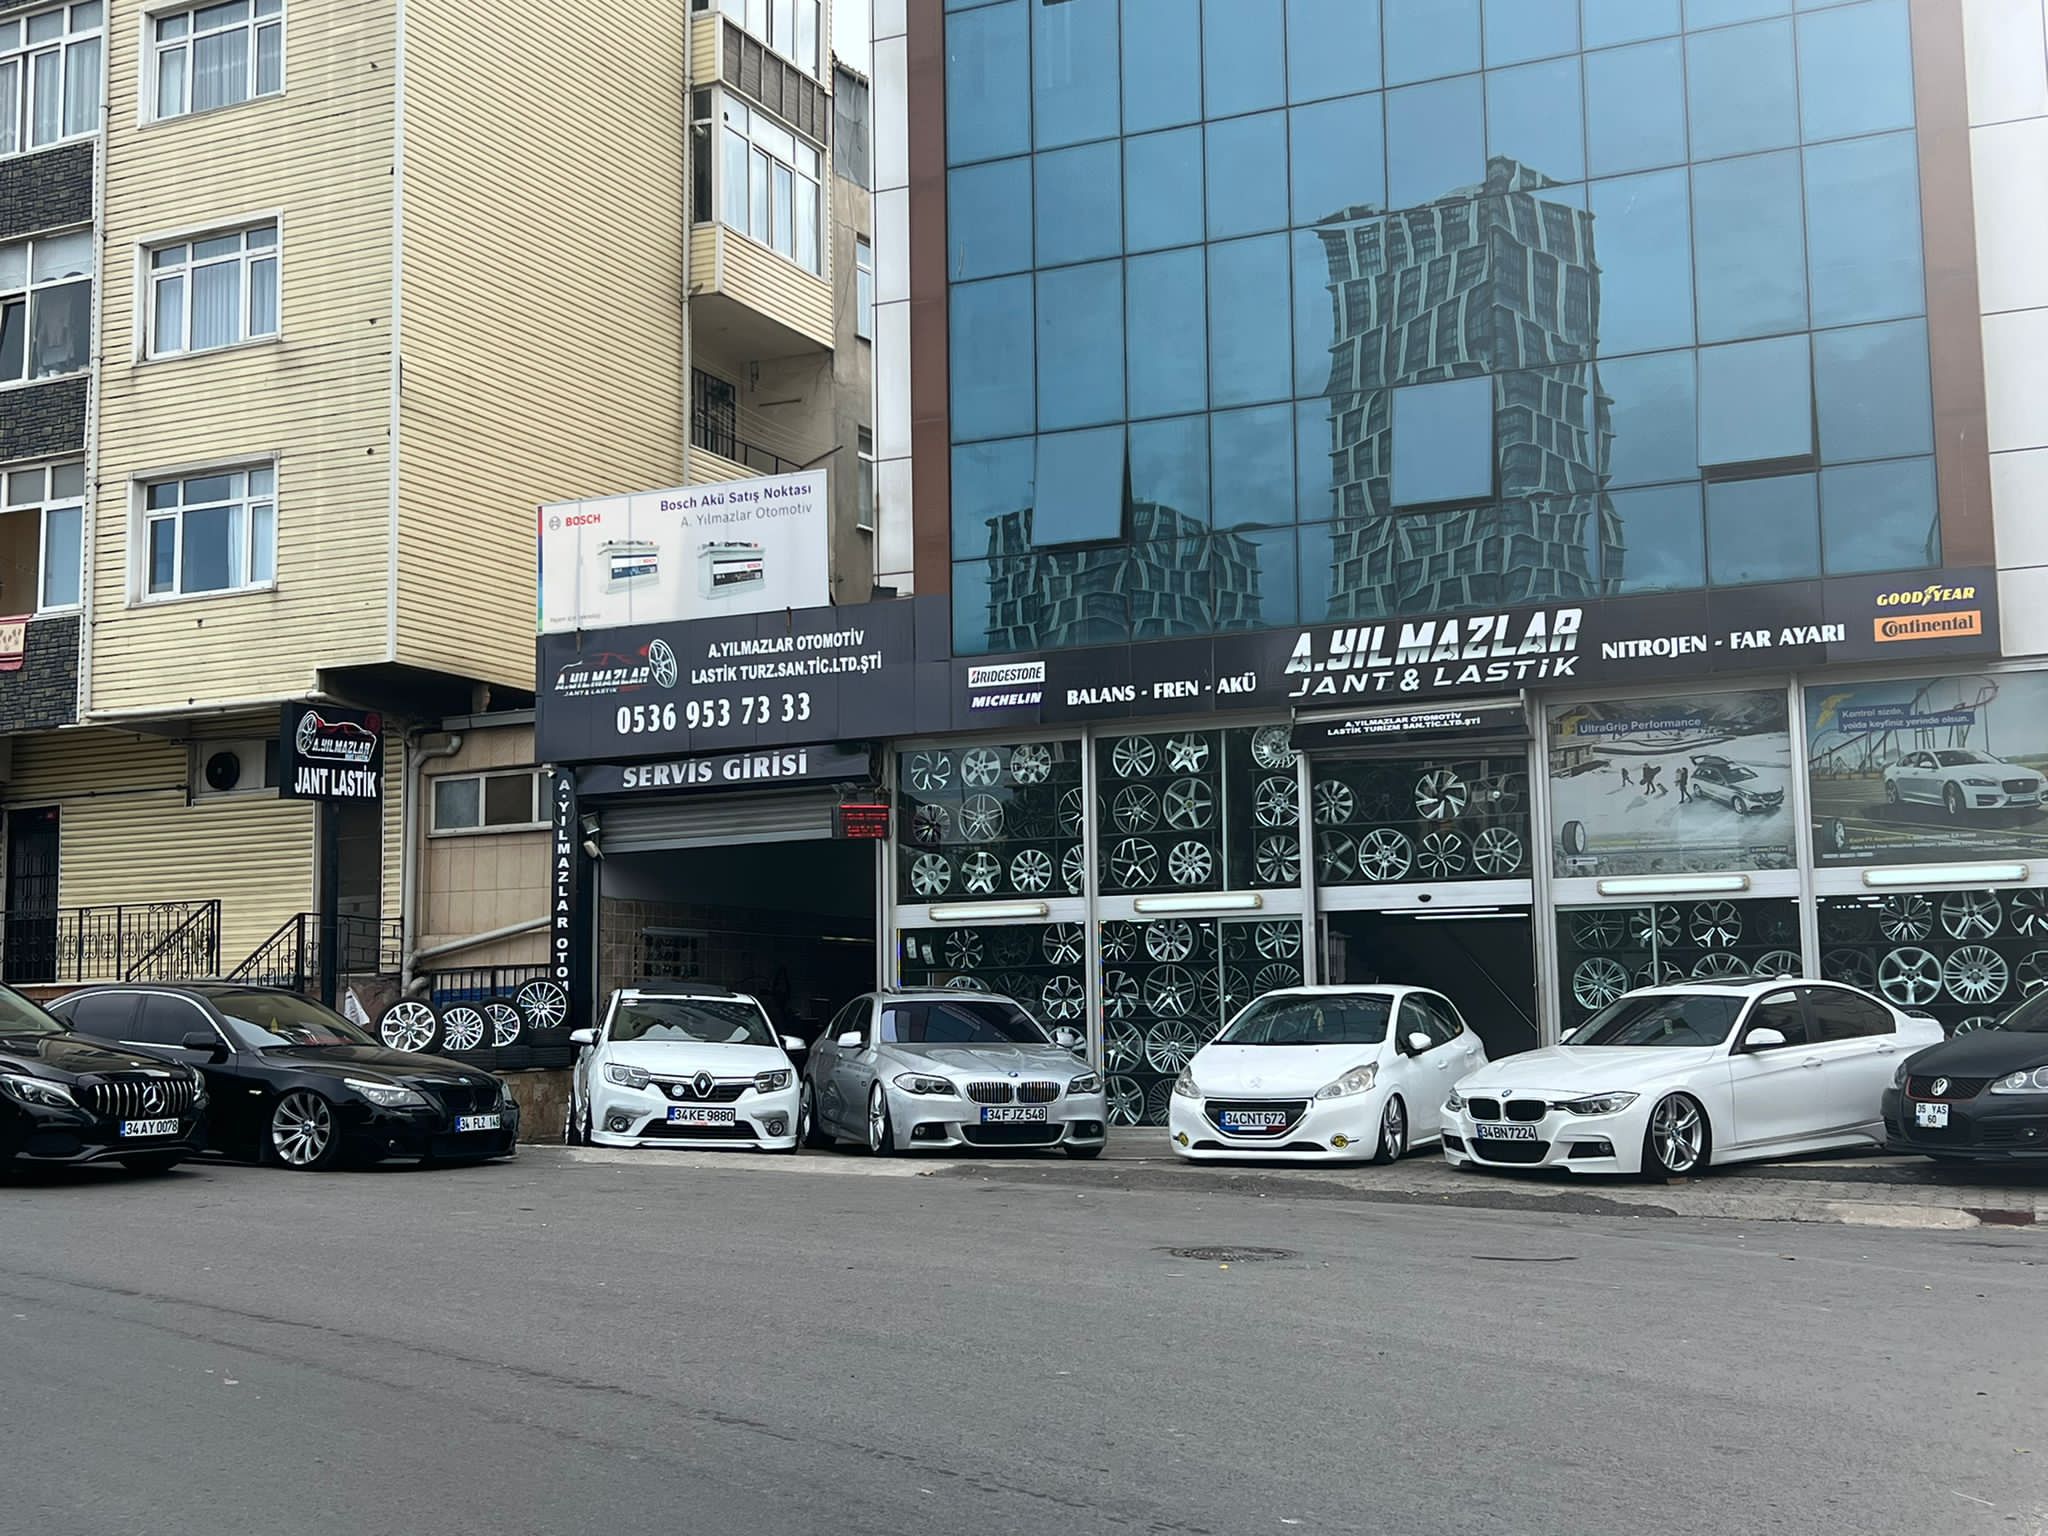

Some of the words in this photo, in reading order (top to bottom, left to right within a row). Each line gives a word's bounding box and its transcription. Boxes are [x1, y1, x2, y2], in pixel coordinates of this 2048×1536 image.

[660, 498, 697, 512] Bosch
[701, 493, 725, 506] Akü
[729, 490, 760, 507] Satış
[763, 485, 812, 500] Noktası
[565, 513, 601, 527] BOSCH
[681, 517, 692, 528] A.
[697, 511, 751, 527] Yılmazlar
[1876, 585, 1975, 606] GOODYEAR
[1882, 615, 1973, 637] Continental
[708, 637, 793, 659] A.YILMAZLAR
[797, 627, 865, 651] OTOMOTİV
[1284, 608, 1583, 674] A.YILMAZLAR
[1602, 634, 1707, 660] NITROJEN
[1730, 630, 1772, 650] FAR
[1779, 624, 1846, 647] AYARI
[554, 666, 650, 691] A.YILMAZLAR
[691, 663, 737, 685] LASTİK
[970, 666, 1042, 684] BRIDGESTONE
[1288, 671, 1395, 698] JANT
[1399, 669, 1420, 692] &
[1067, 685, 1136, 706] BALANS
[1154, 680, 1199, 700] FREN
[1217, 672, 1256, 694] AKÜ
[971, 692, 1042, 708] MICHELIN
[616, 703, 677, 735] 0536
[686, 698, 731, 730] 953
[740, 695, 770, 724] 73
[781, 691, 811, 721] 33
[1344, 716, 1409, 728] A.YILMAZLAR
[1410, 712, 1462, 723] OTOMOTİV
[1842, 708, 1875, 718] Kontrol
[1327, 726, 1362, 736] LASTİK
[1364, 723, 1401, 733] TURİZM
[1580, 723, 1629, 735] UltraGrip
[1631, 718, 1701, 731] Performance
[312, 738, 371, 754] A.YILMAZLAR
[294, 766, 329, 795] JANT
[331, 764, 377, 798] LASTİK
[622, 758, 713, 788] SERVİS
[707, 1111, 734, 1122] 9880
[1932, 1105, 1947, 1114] YAS
[126, 1122, 139, 1135] 34
[140, 1121, 155, 1134] AY
